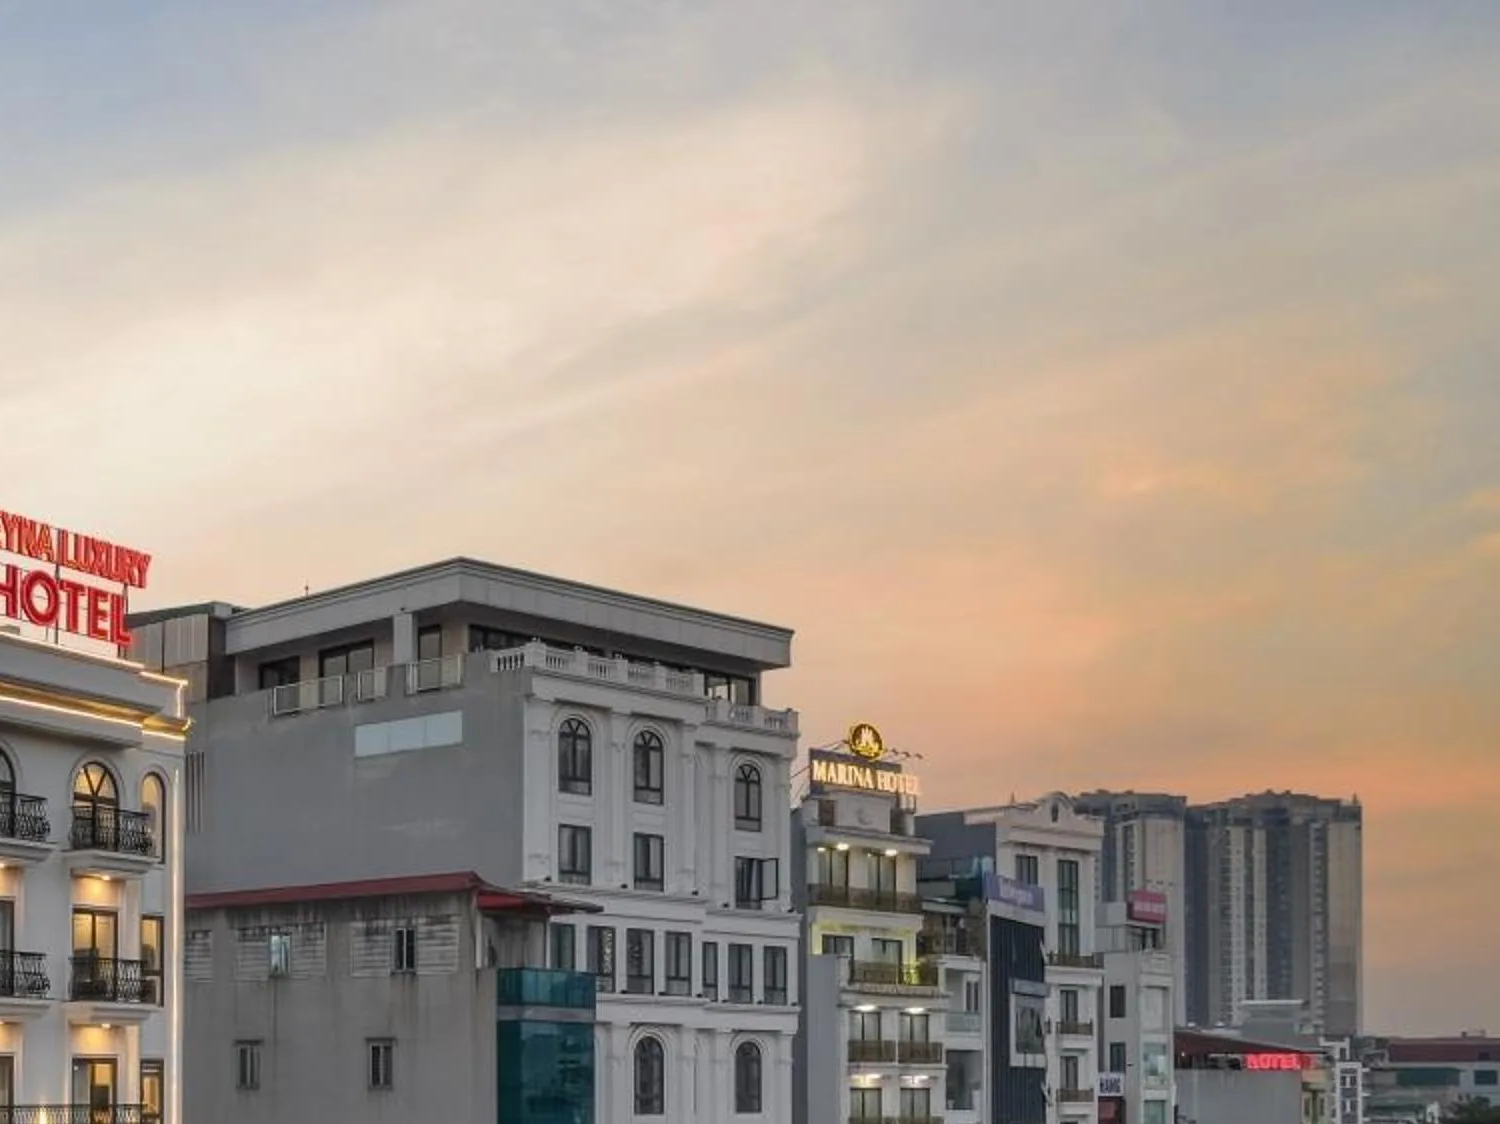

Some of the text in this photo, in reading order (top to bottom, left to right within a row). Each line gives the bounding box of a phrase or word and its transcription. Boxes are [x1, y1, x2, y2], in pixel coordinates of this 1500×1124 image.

[57, 529, 152, 589] LUXURY
[812, 760, 921, 796] MARINA HOTEL
